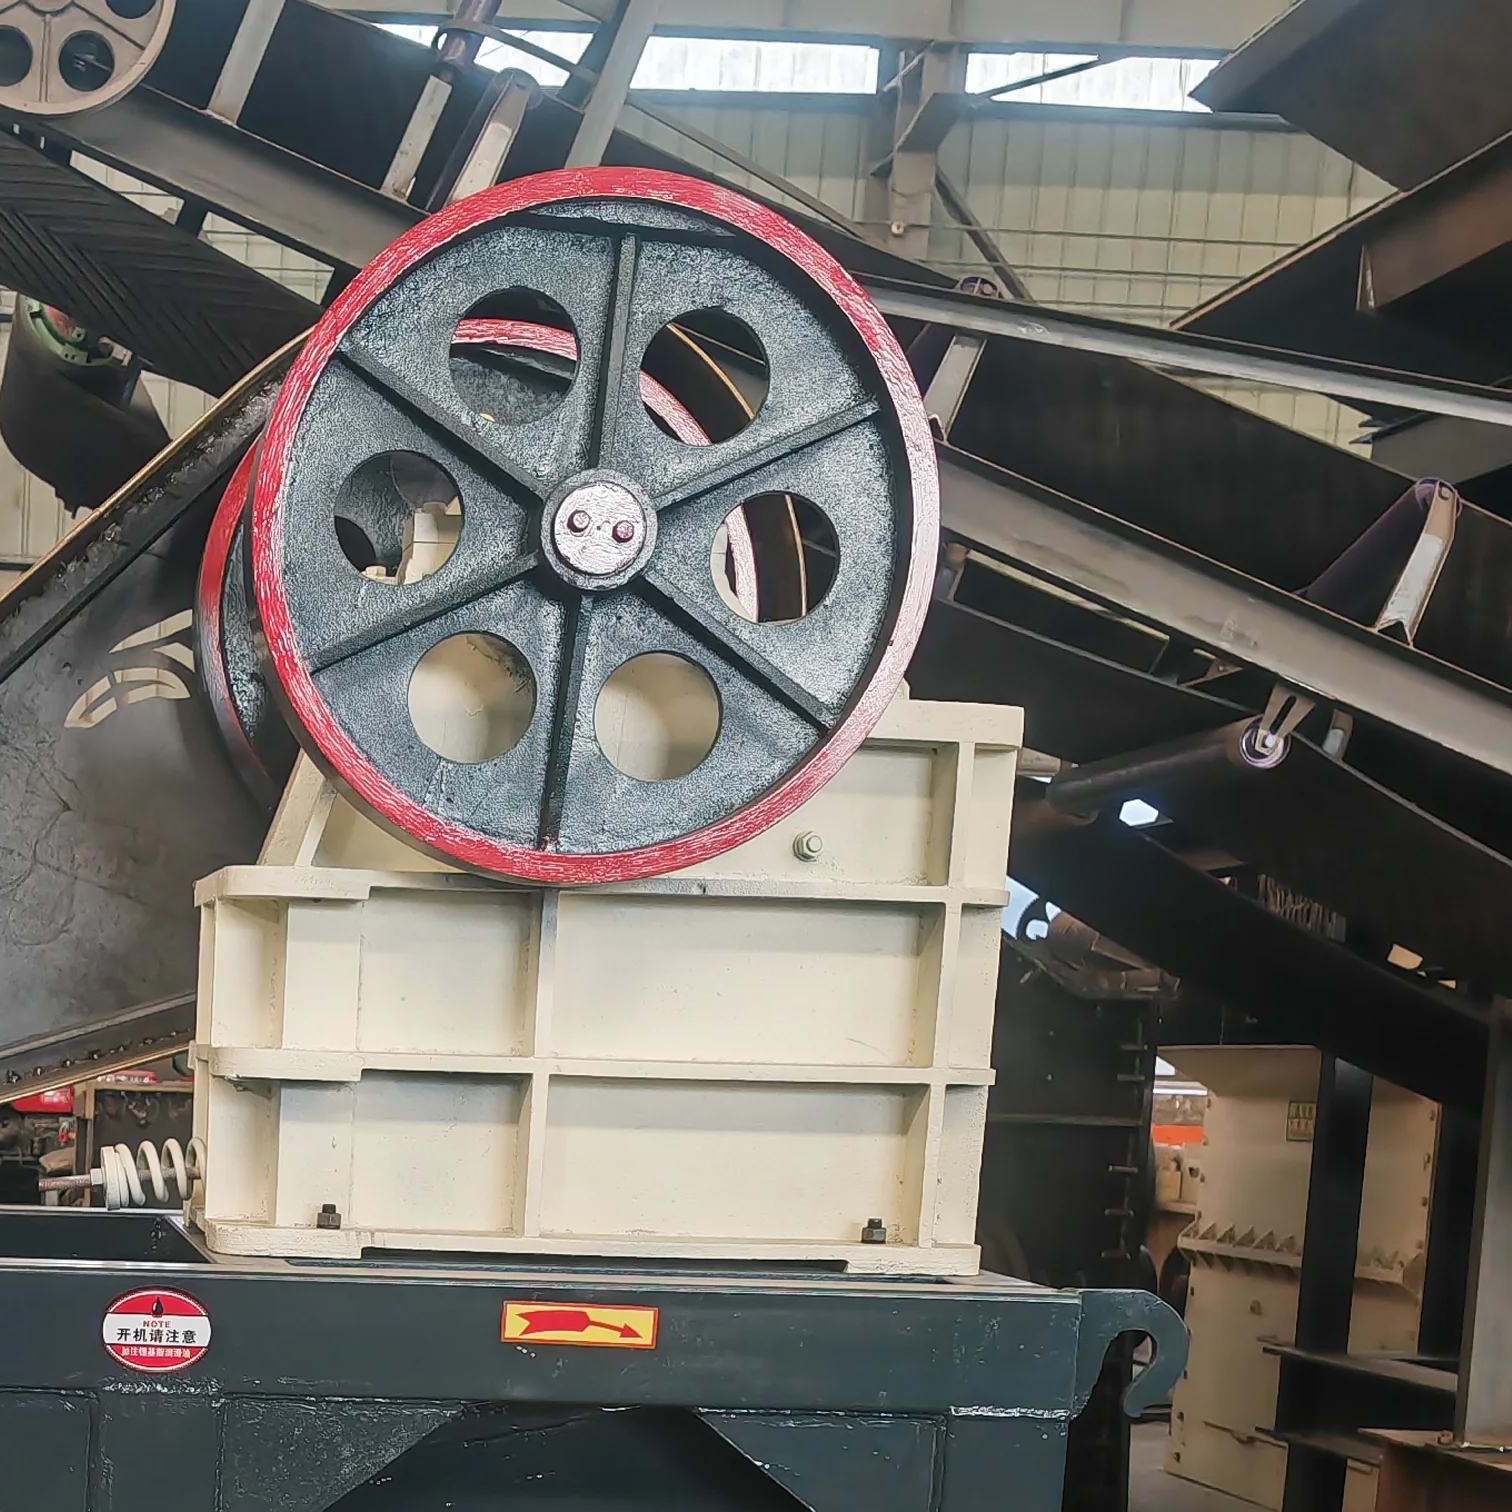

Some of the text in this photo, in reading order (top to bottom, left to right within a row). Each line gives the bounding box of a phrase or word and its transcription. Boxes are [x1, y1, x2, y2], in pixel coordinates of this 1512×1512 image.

[143, 1320, 171, 1328] NOTE
[117, 1328, 196, 1343] 开机请注意
